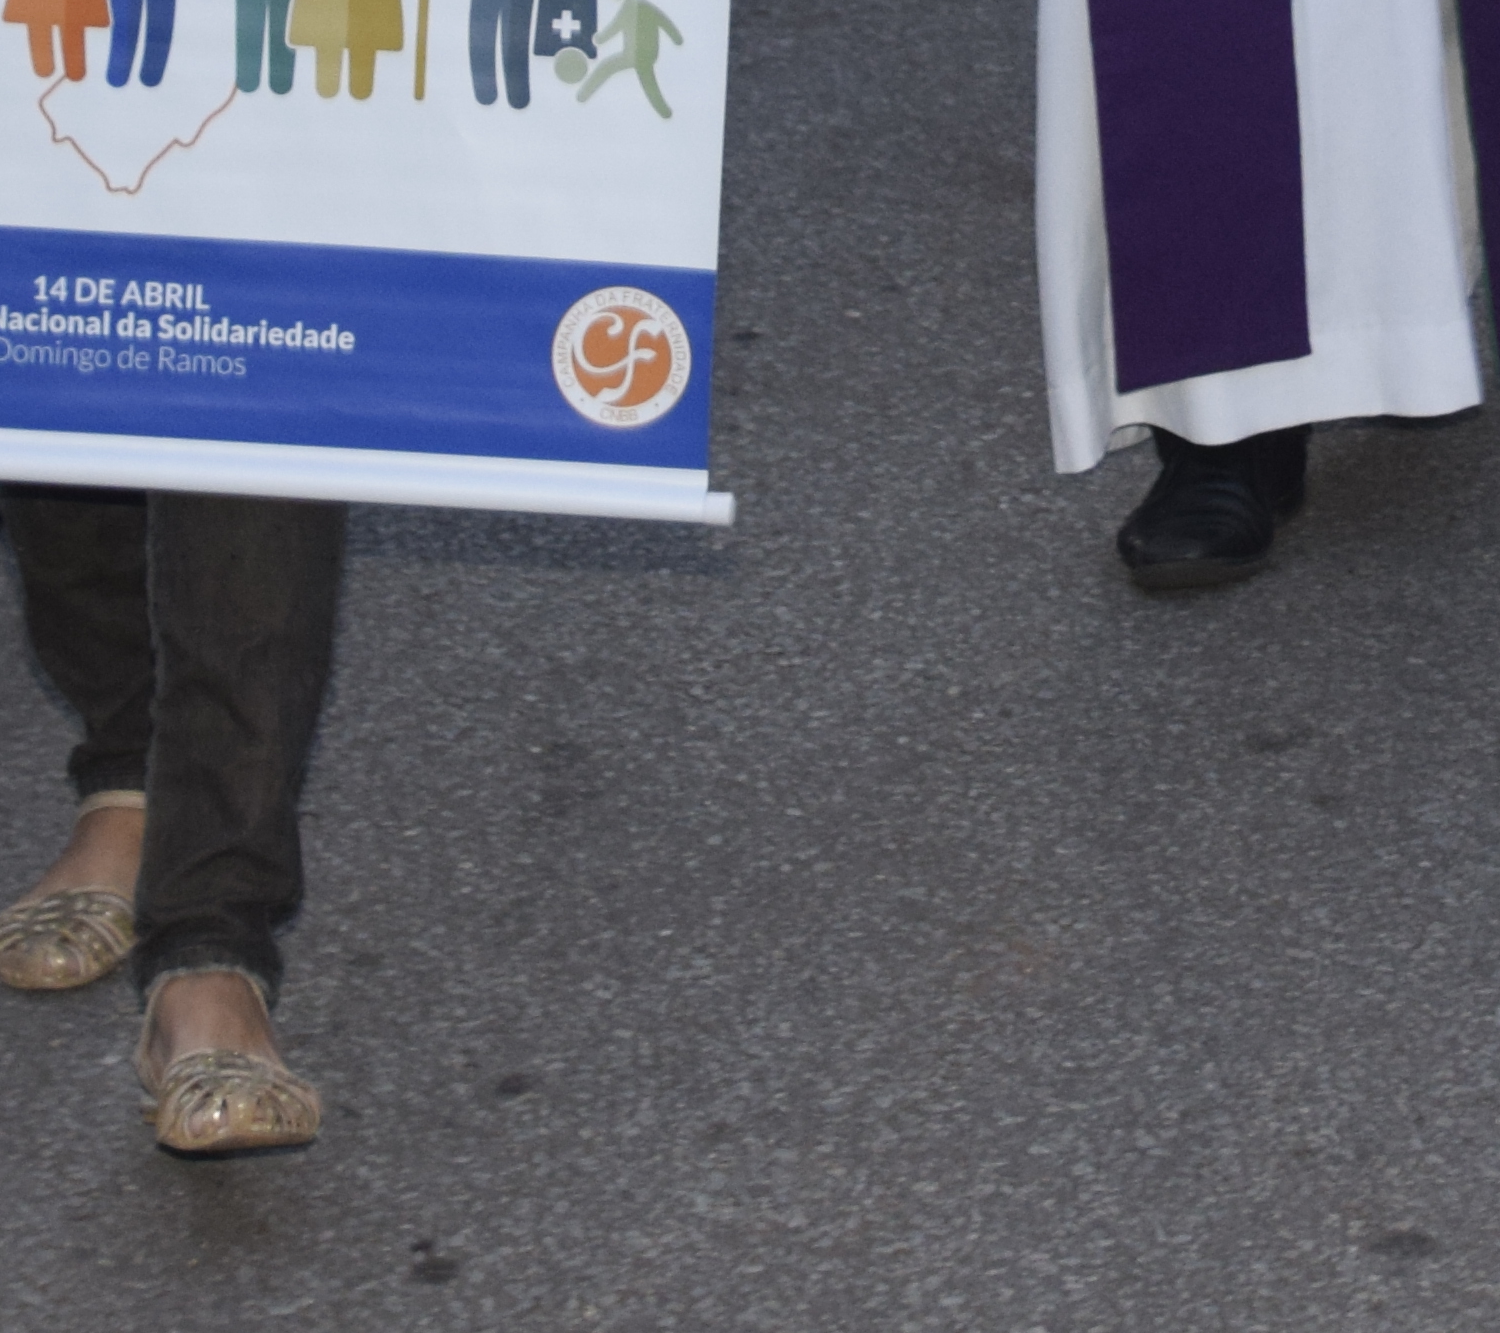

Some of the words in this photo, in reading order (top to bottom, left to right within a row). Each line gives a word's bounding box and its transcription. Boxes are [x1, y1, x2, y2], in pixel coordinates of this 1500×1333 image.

[33, 275, 68, 303] 14
[75, 277, 116, 306] DE
[120, 279, 211, 312] ABRIL
[116, 311, 152, 340] da
[157, 313, 356, 352] Solidariedade
[117, 344, 150, 370] de
[158, 345, 247, 376] Ramos
[600, 408, 639, 422] CNBB
